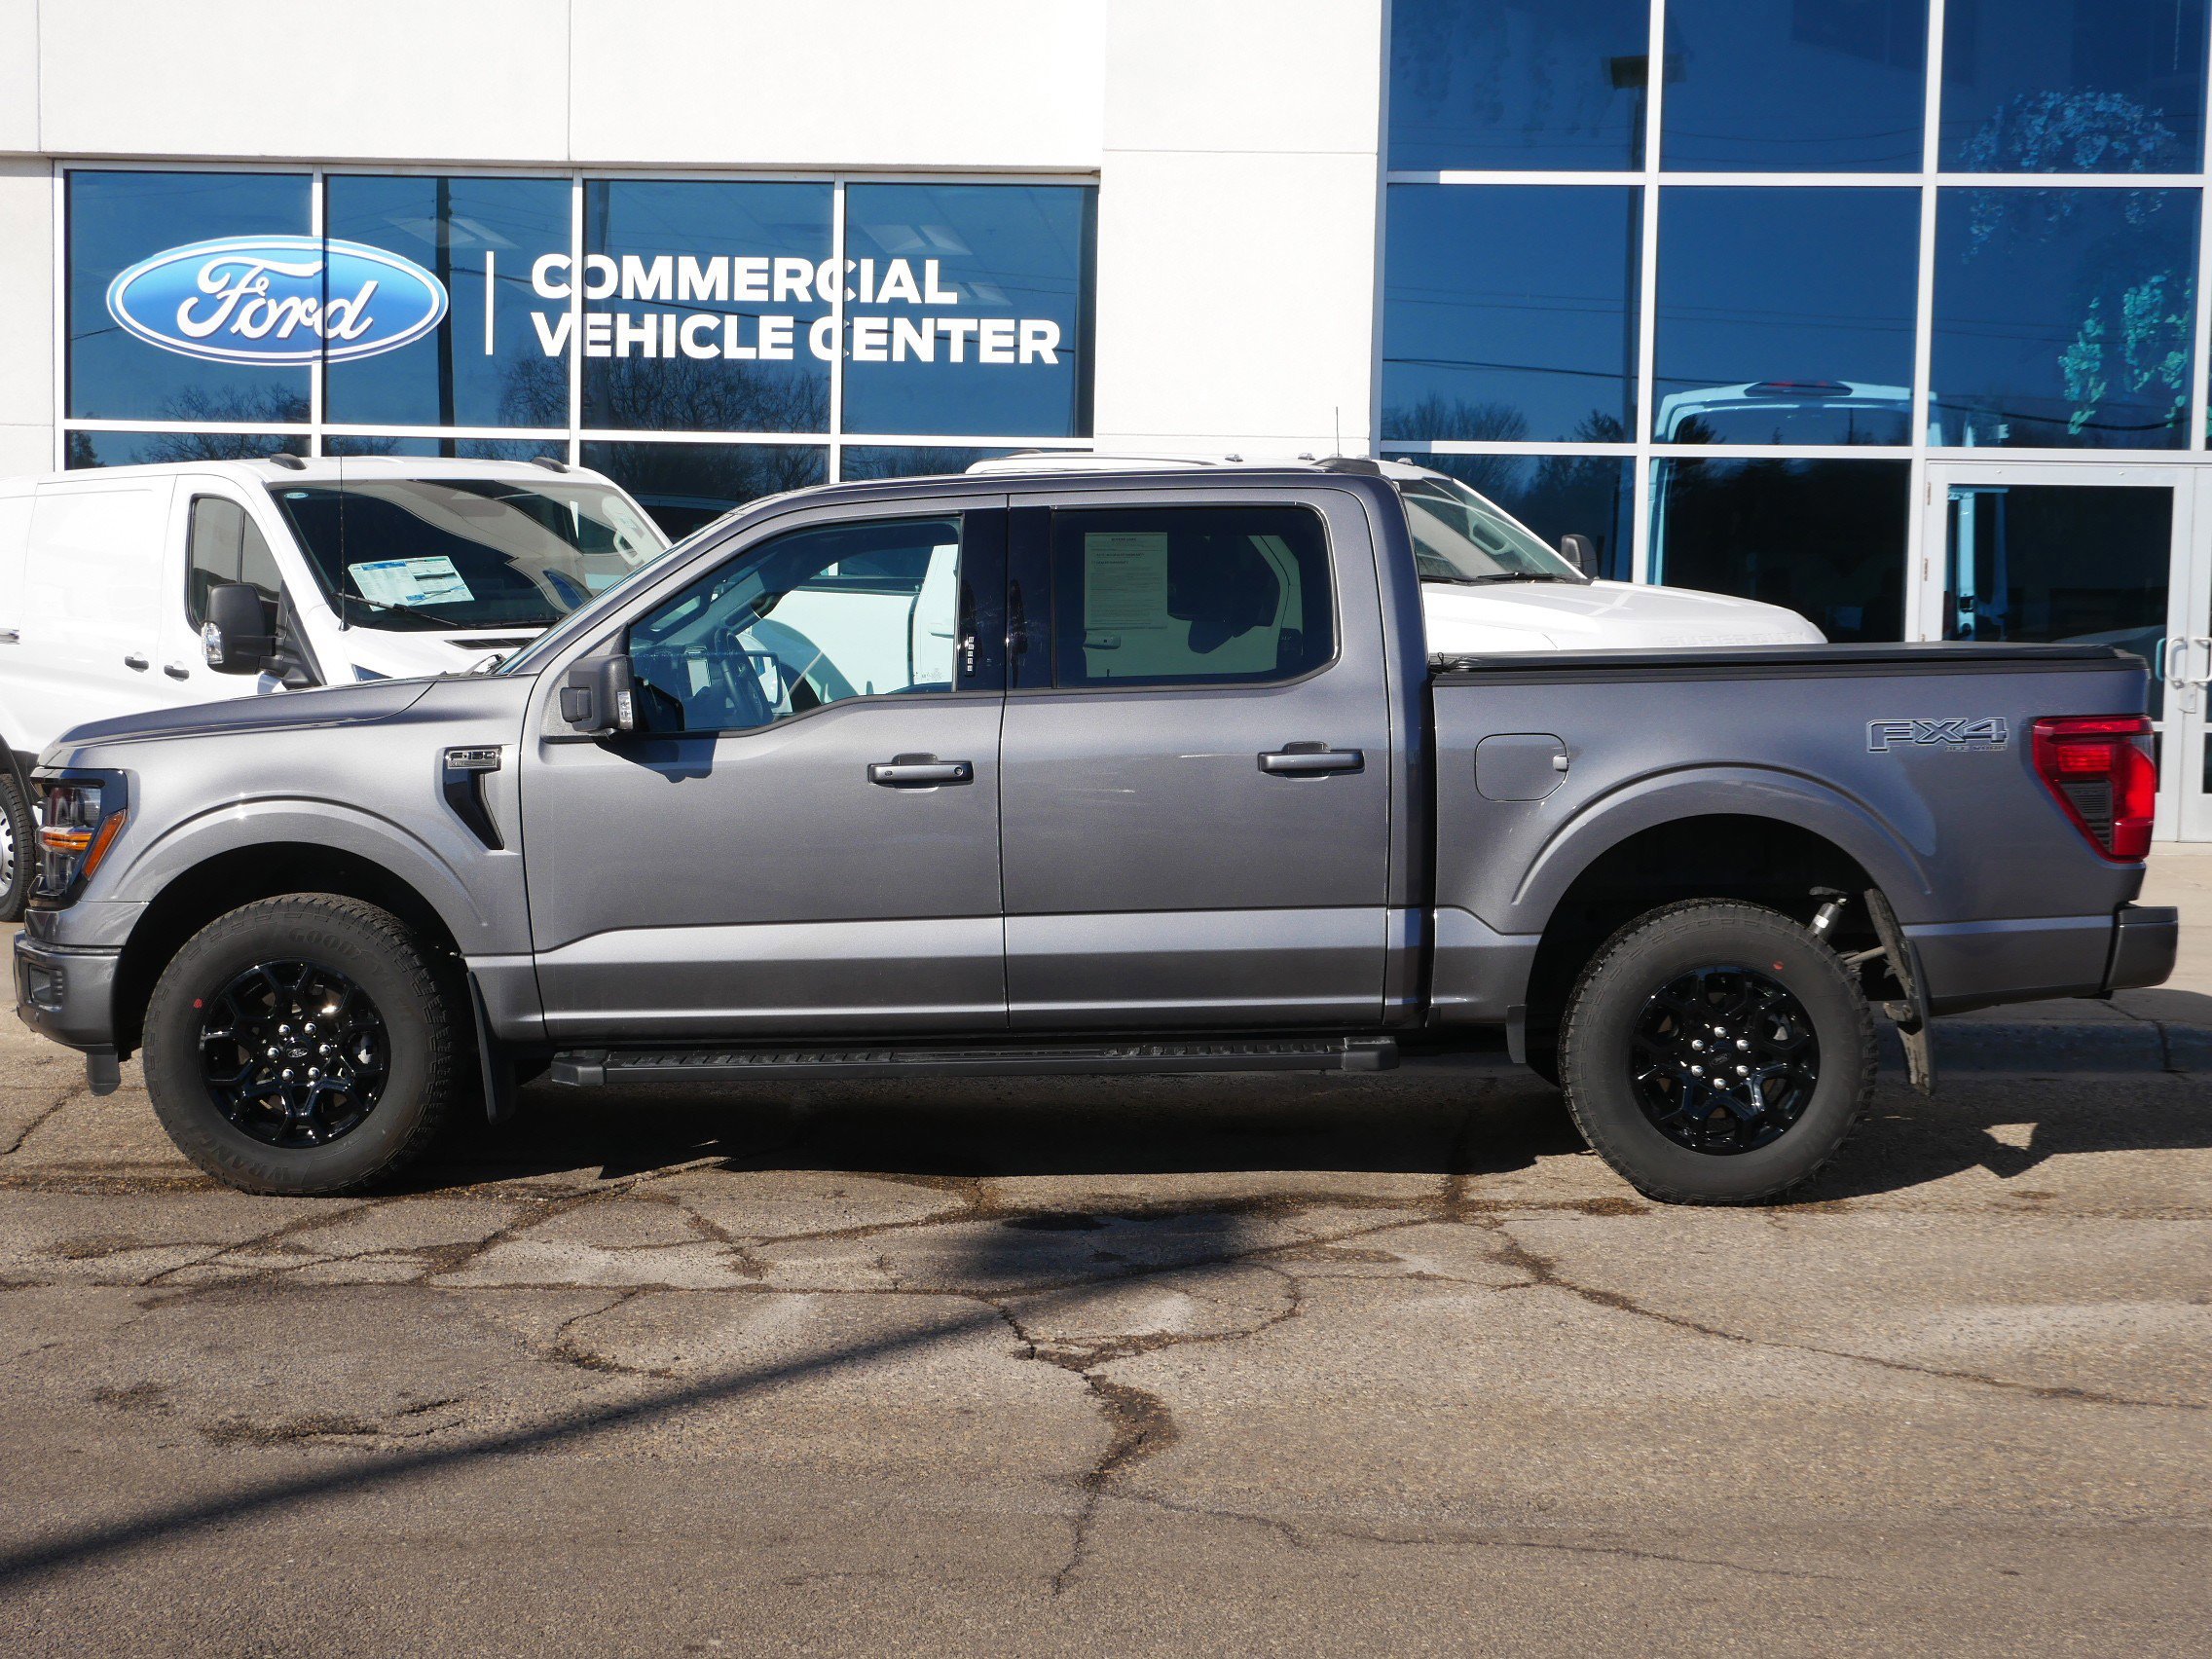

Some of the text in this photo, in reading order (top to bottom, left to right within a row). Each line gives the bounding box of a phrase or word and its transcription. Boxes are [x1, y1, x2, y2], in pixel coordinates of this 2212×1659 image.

[176, 255, 380, 340] Ford
[531, 253, 959, 305] COMMERCIAL
[530, 312, 1062, 365] VEHICLE CENTER
[1865, 717, 2009, 753] FX4
